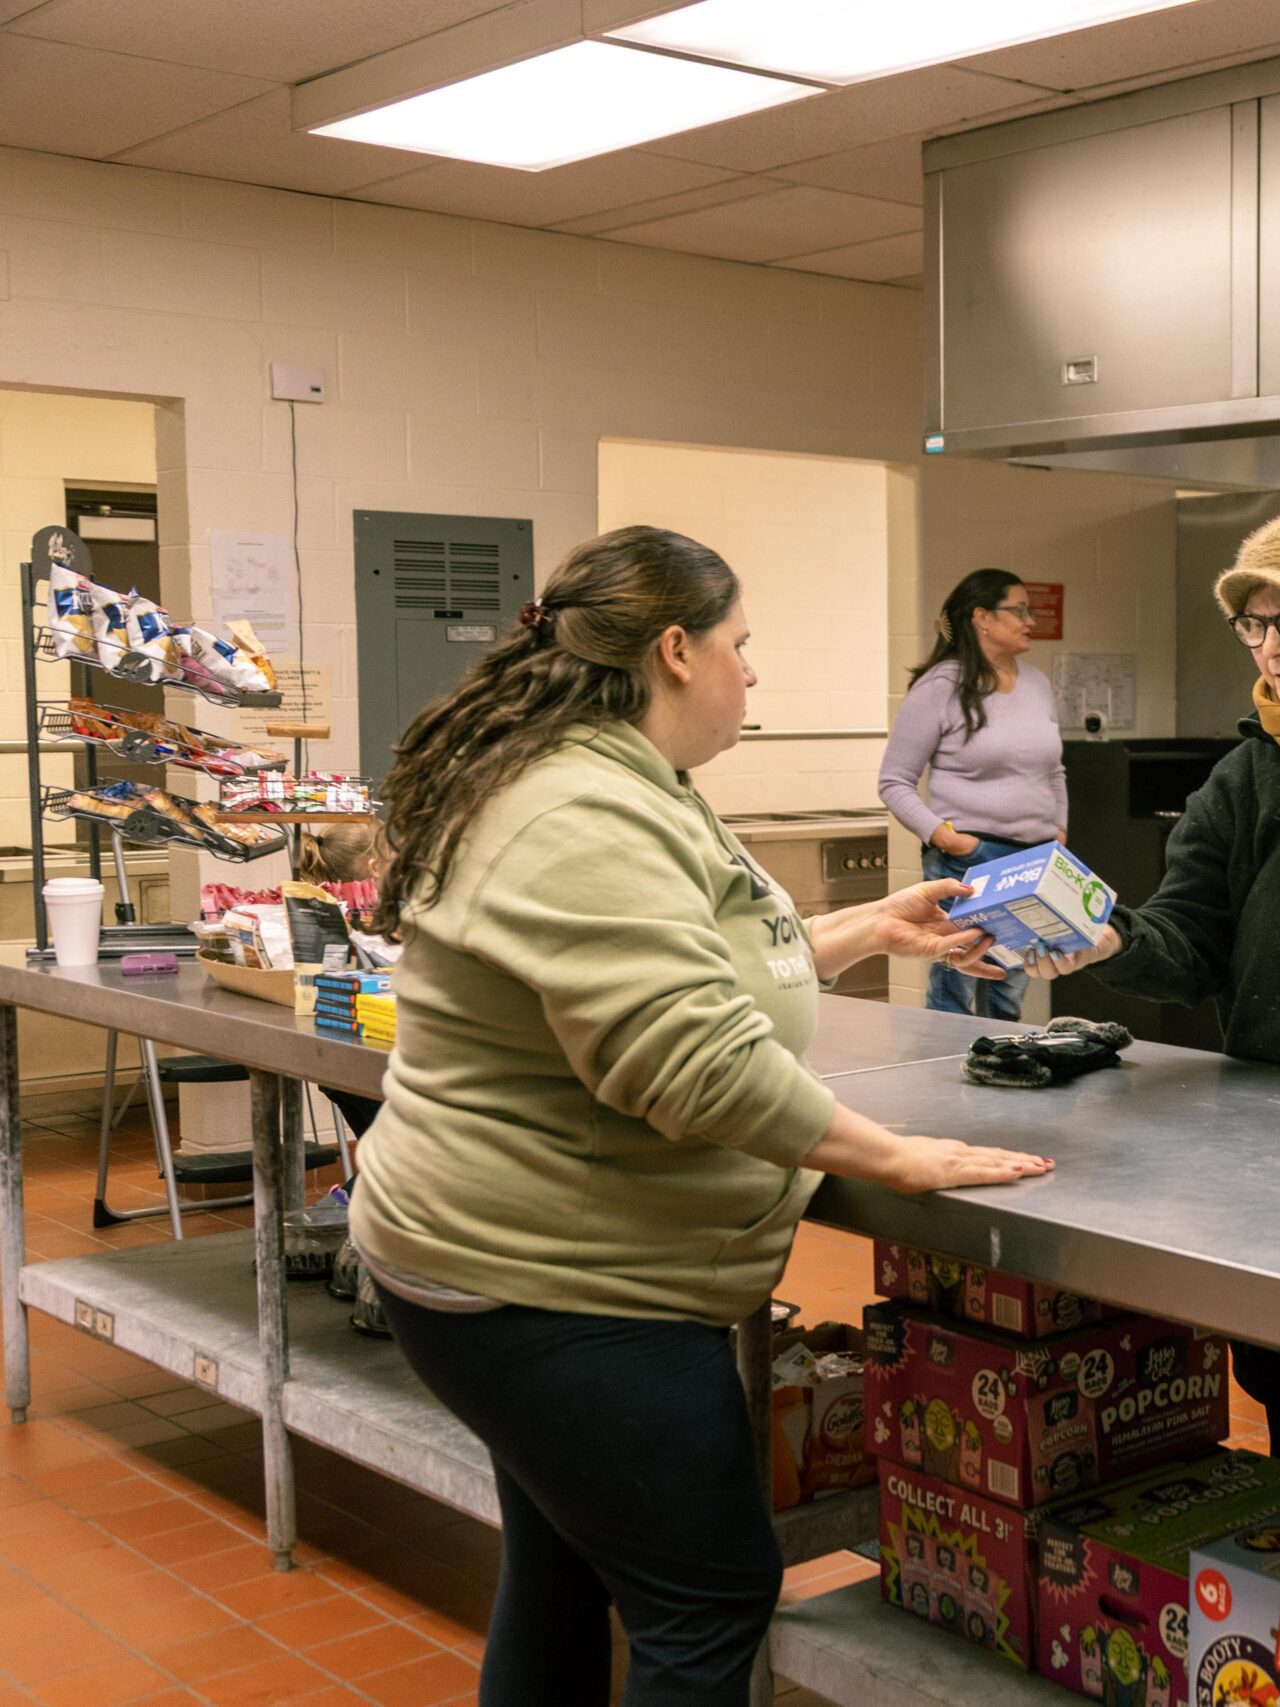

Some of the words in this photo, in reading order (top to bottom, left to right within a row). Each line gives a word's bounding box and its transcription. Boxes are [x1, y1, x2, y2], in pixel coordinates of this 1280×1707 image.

[1083, 1353, 1107, 1380] 24
[977, 1374, 999, 1400] 24
[1100, 1373, 1222, 1434] POPCORN
[1039, 1424, 1088, 1451] POPCORN
[887, 1475, 957, 1518] COLLECT
[959, 1503, 991, 1533] ALL
[1141, 1478, 1265, 1524] POPCORN
[1200, 1582, 1218, 1604] 6
[1218, 1582, 1227, 1614] BAGS
[1166, 1608, 1190, 1638] 24
[1200, 1637, 1241, 1686] BOOTY
